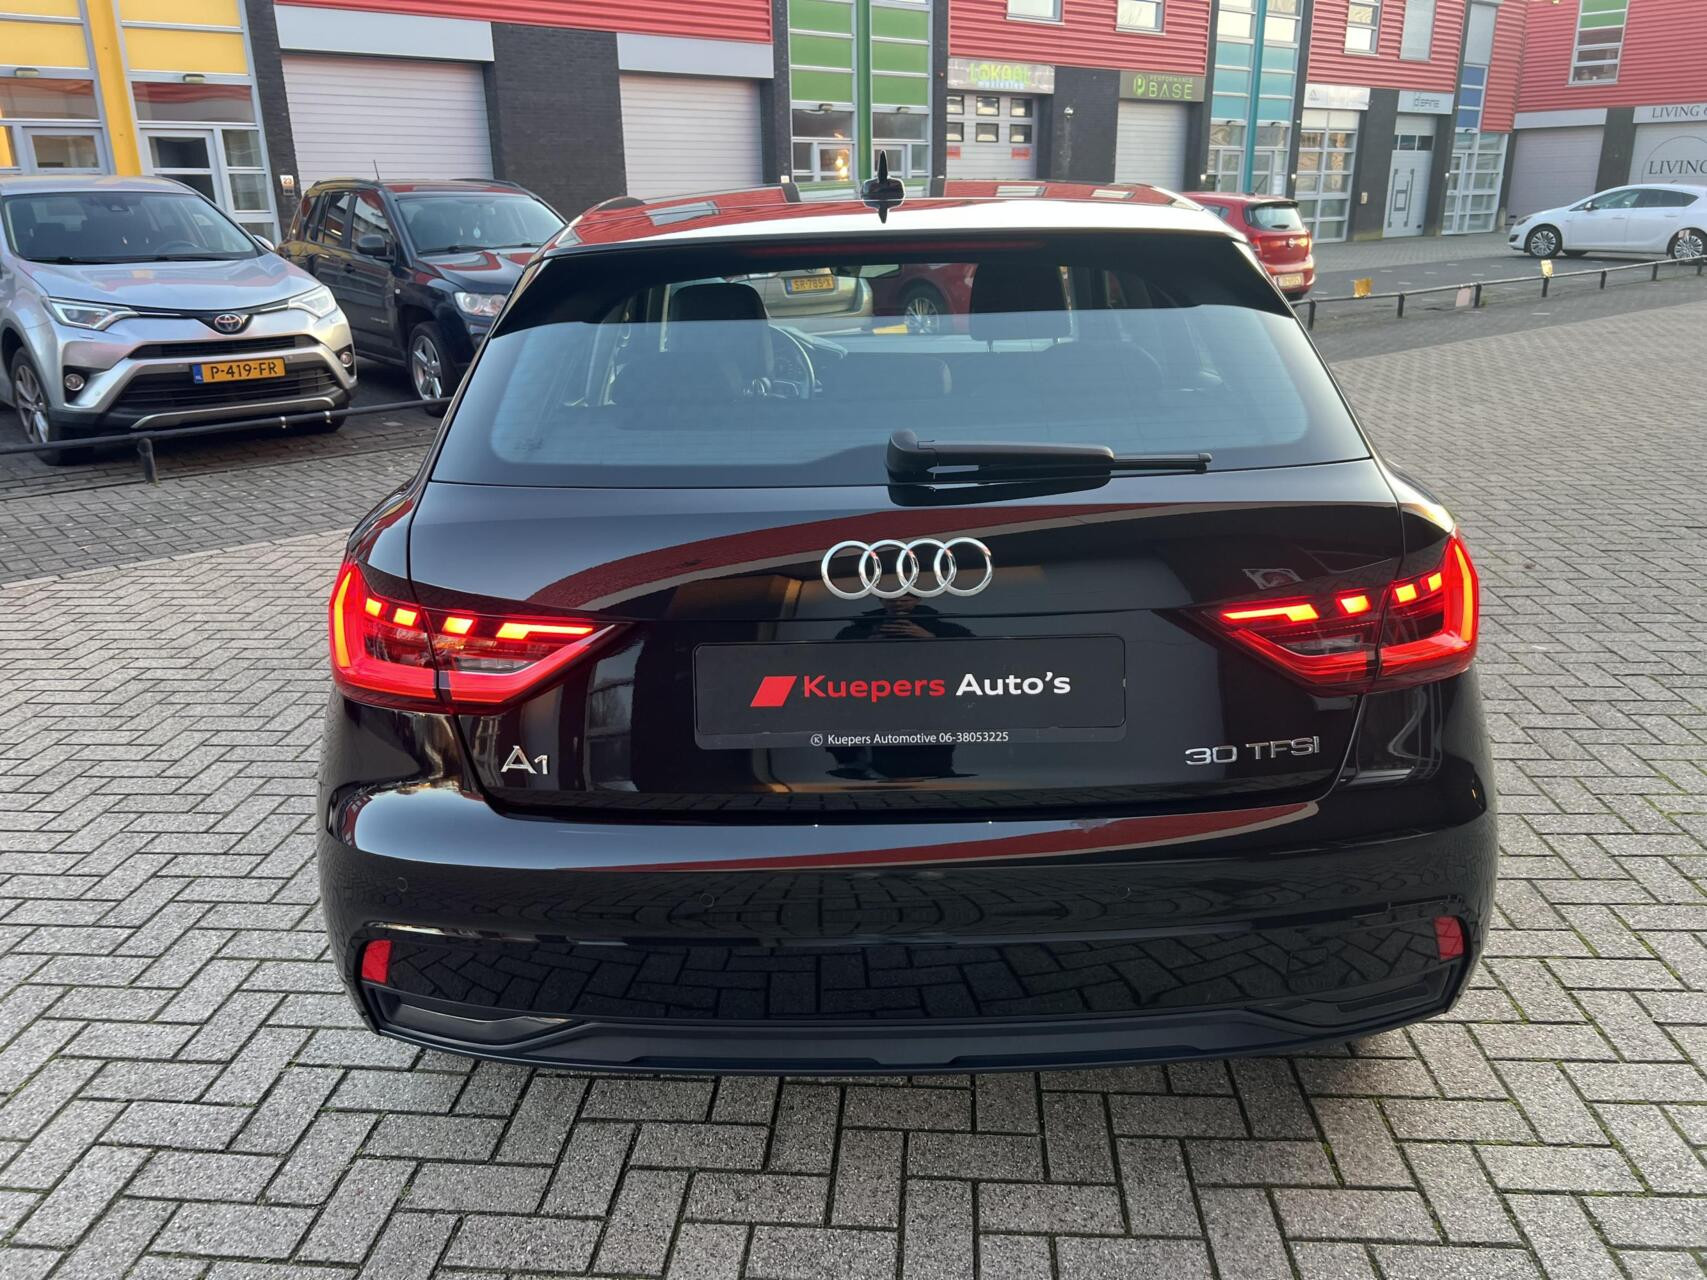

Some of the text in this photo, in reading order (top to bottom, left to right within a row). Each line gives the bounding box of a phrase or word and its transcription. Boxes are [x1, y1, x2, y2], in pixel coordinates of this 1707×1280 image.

[1149, 82, 1193, 99] BASE
[1652, 105, 1701, 118] LIVING
[210, 361, 277, 379] P-419-FR
[803, 671, 1071, 702] Kuepers Auto's
[828, 734, 871, 746] Kuepers
[873, 732, 937, 744] Automotive
[939, 731, 1009, 743] 06-38053225
[1185, 735, 1320, 765] 30 TFSI
[500, 744, 548, 775] A1
